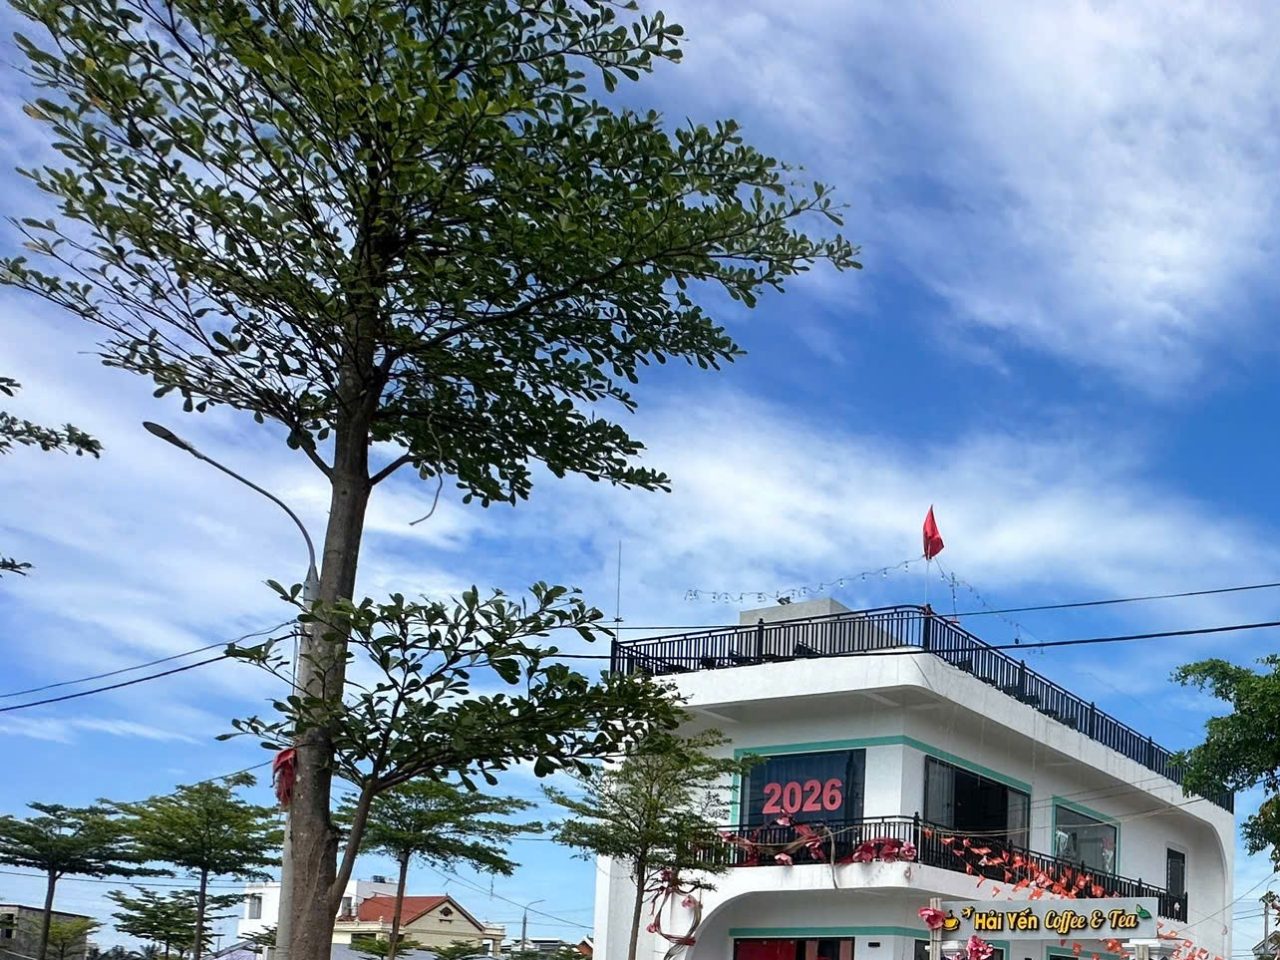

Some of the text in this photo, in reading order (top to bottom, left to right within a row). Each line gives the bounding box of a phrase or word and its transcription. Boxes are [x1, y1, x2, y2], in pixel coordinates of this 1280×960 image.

[762, 778, 842, 814] 2026
[974, 907, 1138, 934] Hải Yến Coffee & Tea
